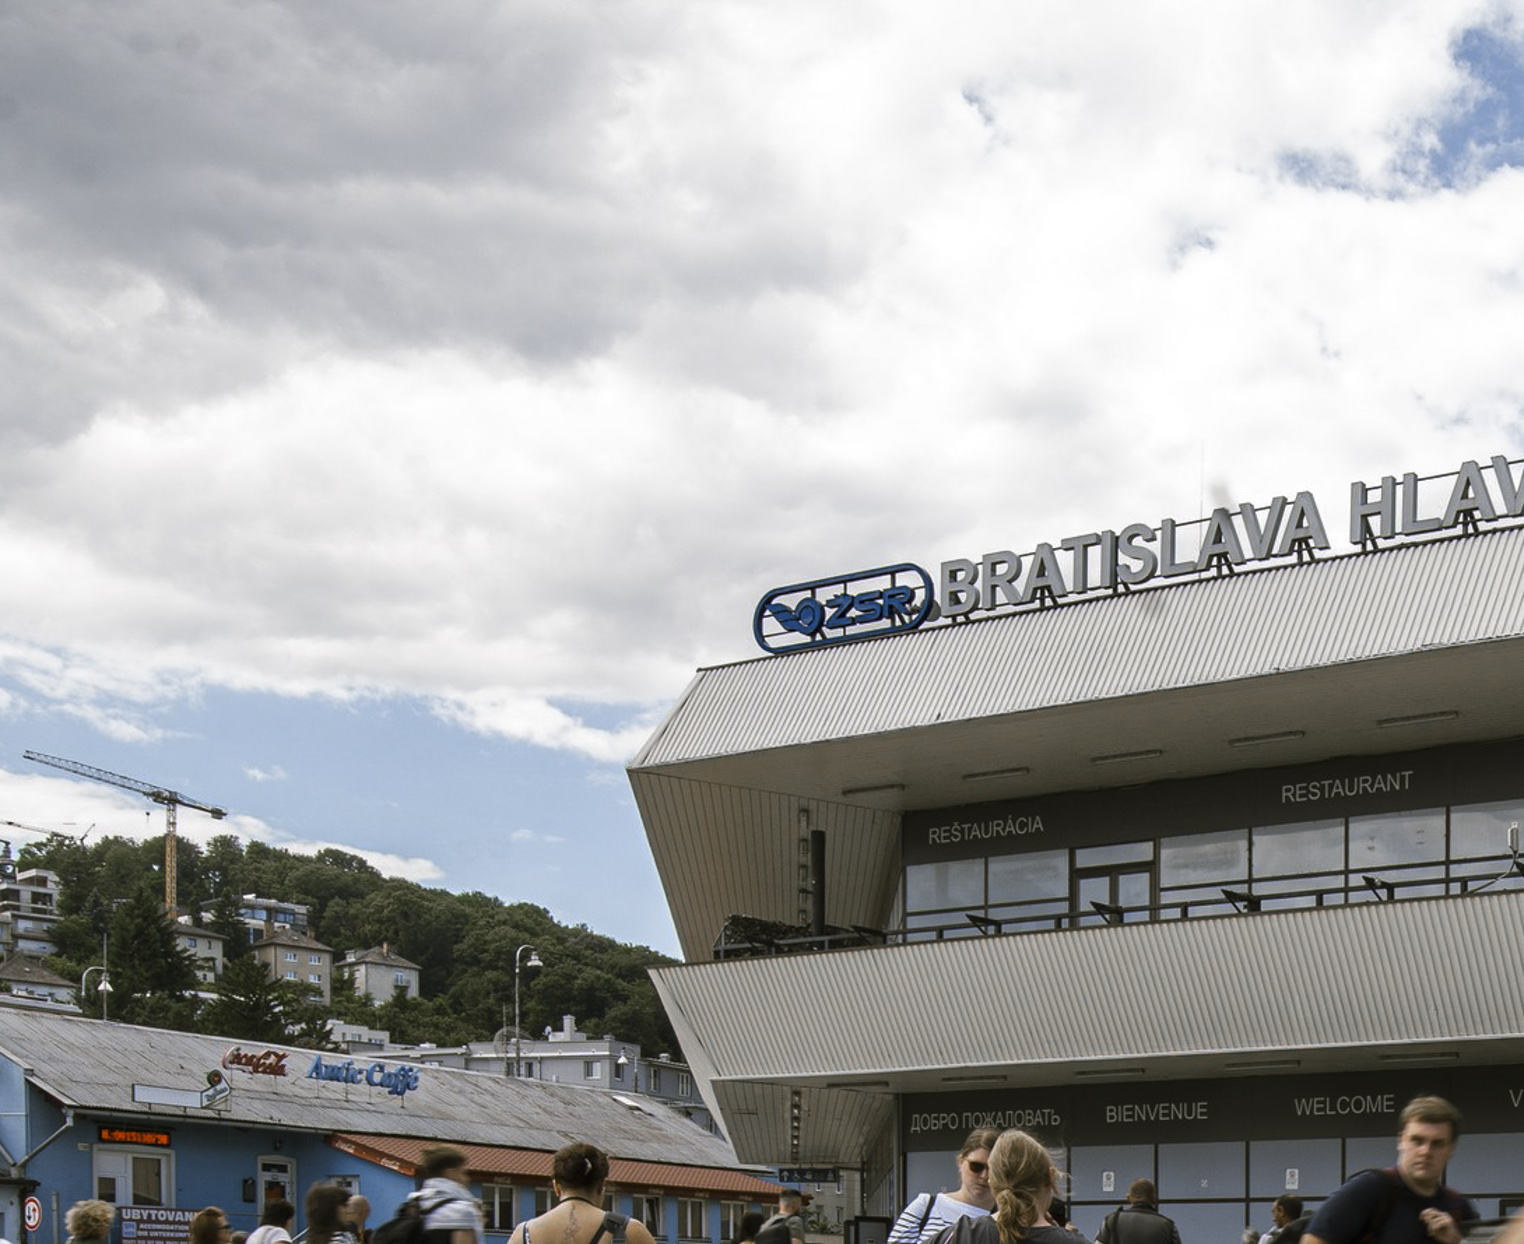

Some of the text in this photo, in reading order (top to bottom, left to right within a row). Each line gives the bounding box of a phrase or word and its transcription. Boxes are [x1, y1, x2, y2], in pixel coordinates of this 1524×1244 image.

[940, 490, 1331, 618] BRATISLAVA
[1281, 771, 1414, 803] RESTAURANT
[929, 815, 1044, 845] REŠTAURÁCIA
[1106, 1102, 1208, 1123] BIENVENUE
[1294, 1094, 1395, 1116] WELCOME
[910, 1109, 1061, 1133] ДОБРО ПОЖАЛОВАТЬ
